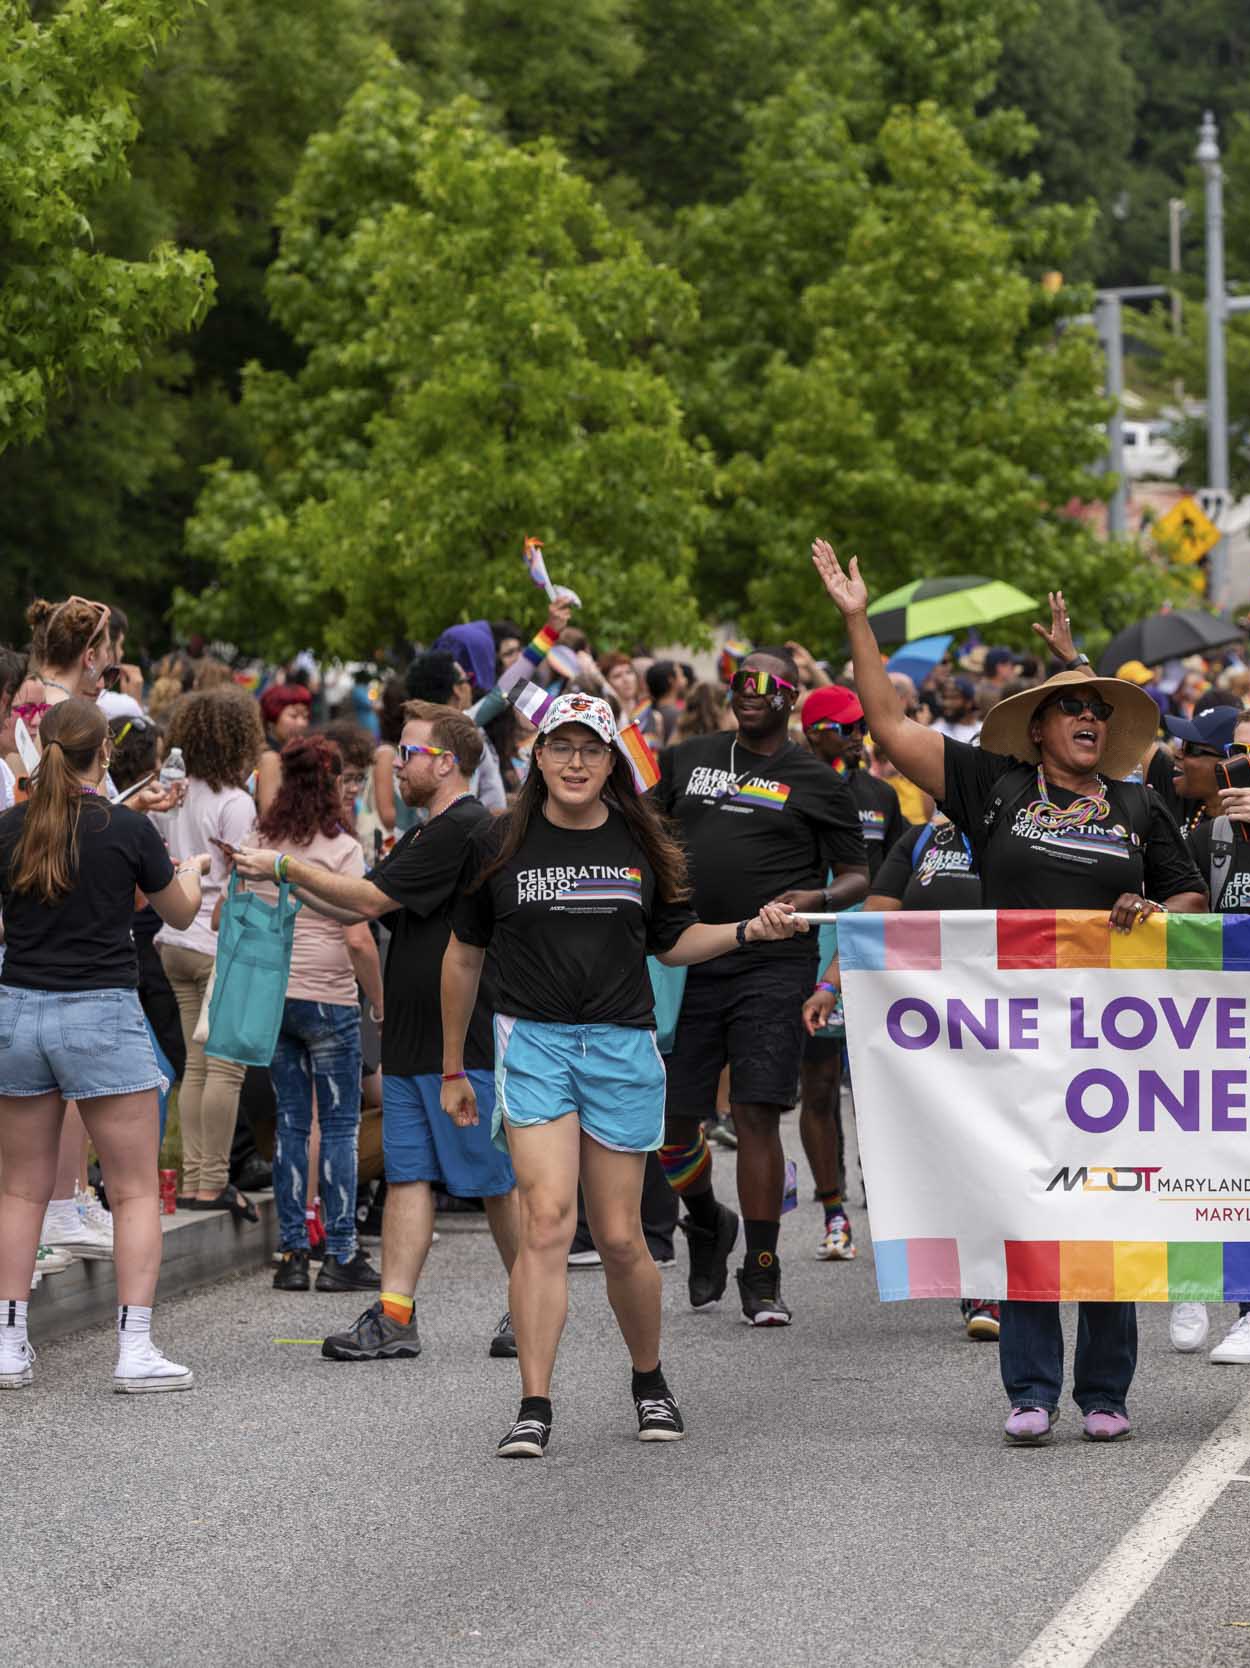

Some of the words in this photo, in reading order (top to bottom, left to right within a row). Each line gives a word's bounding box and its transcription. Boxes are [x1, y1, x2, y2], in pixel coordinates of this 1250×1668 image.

[516, 865, 632, 883] CELEBRATING
[518, 879, 580, 894] LGBTQ+
[518, 889, 563, 905] PRIDE
[886, 997, 1039, 1050] ONE
[1065, 1068, 1247, 1133] ONE
